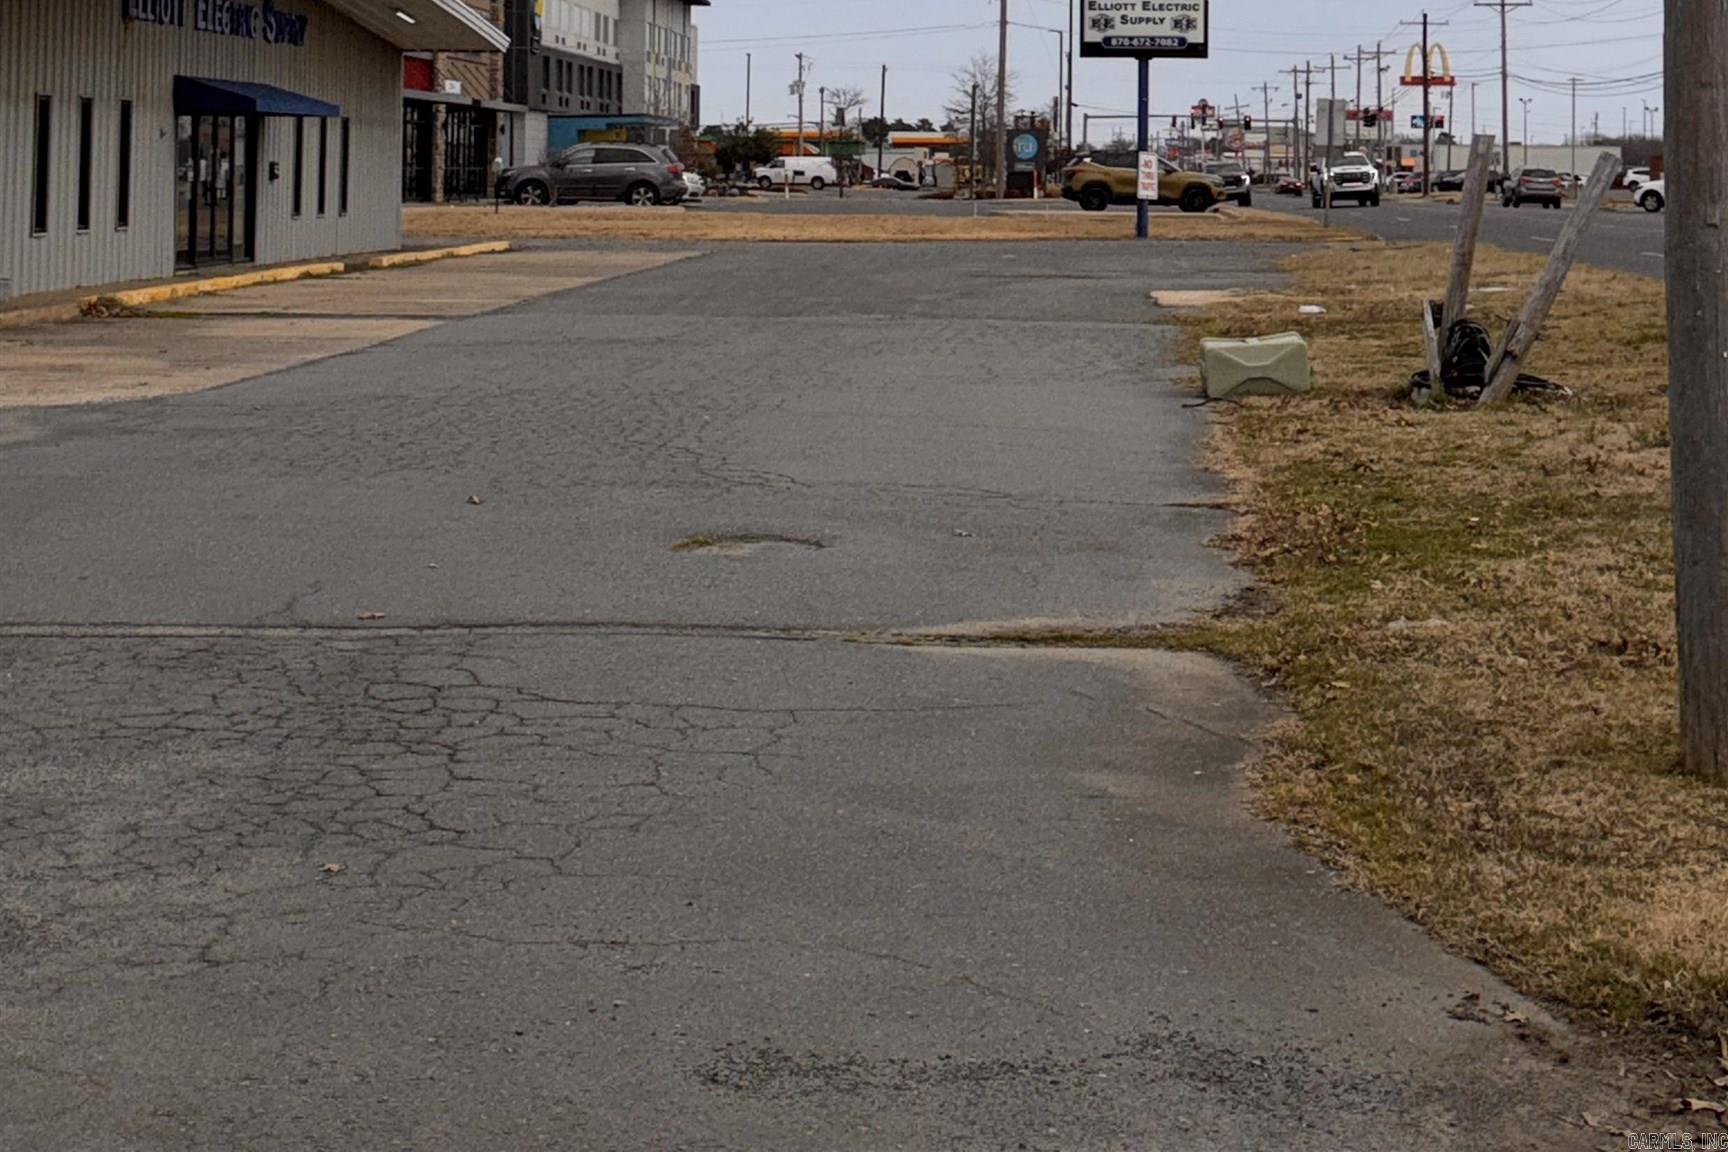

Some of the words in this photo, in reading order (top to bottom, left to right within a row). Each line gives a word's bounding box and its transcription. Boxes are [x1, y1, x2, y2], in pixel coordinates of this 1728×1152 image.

[1088, 0, 1137, 12] ELLIOTT
[1141, 0, 1200, 12] ELECTRIC
[1119, 14, 1166, 25] SUPPLY
